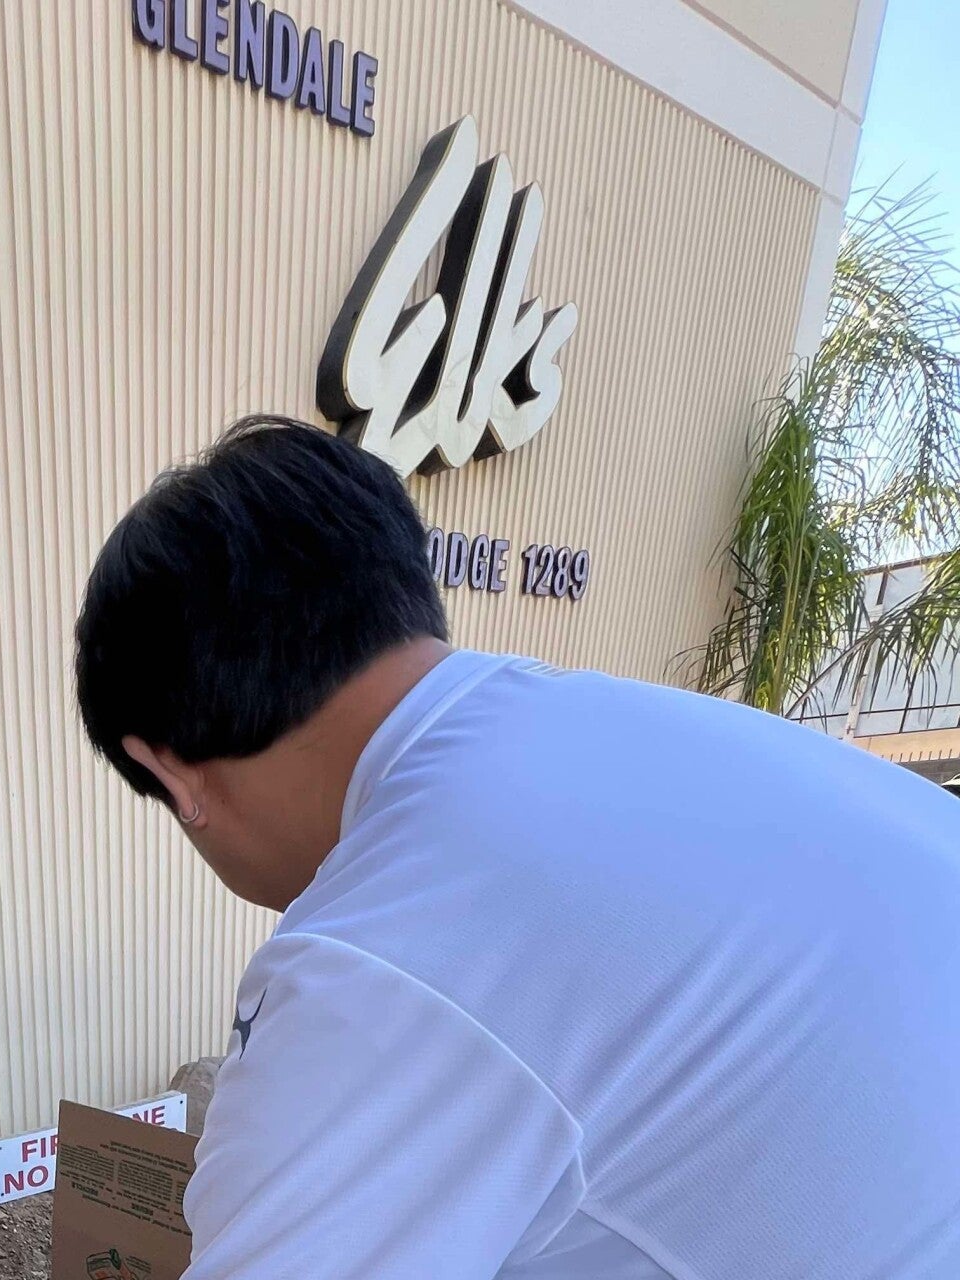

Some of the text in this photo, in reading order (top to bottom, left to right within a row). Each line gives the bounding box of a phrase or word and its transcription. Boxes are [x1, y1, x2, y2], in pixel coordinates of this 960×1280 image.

[133, 0, 378, 137] GLENDALE
[426, 527, 589, 600] ODGE 1289
[4, 1166, 49, 1194] NO
